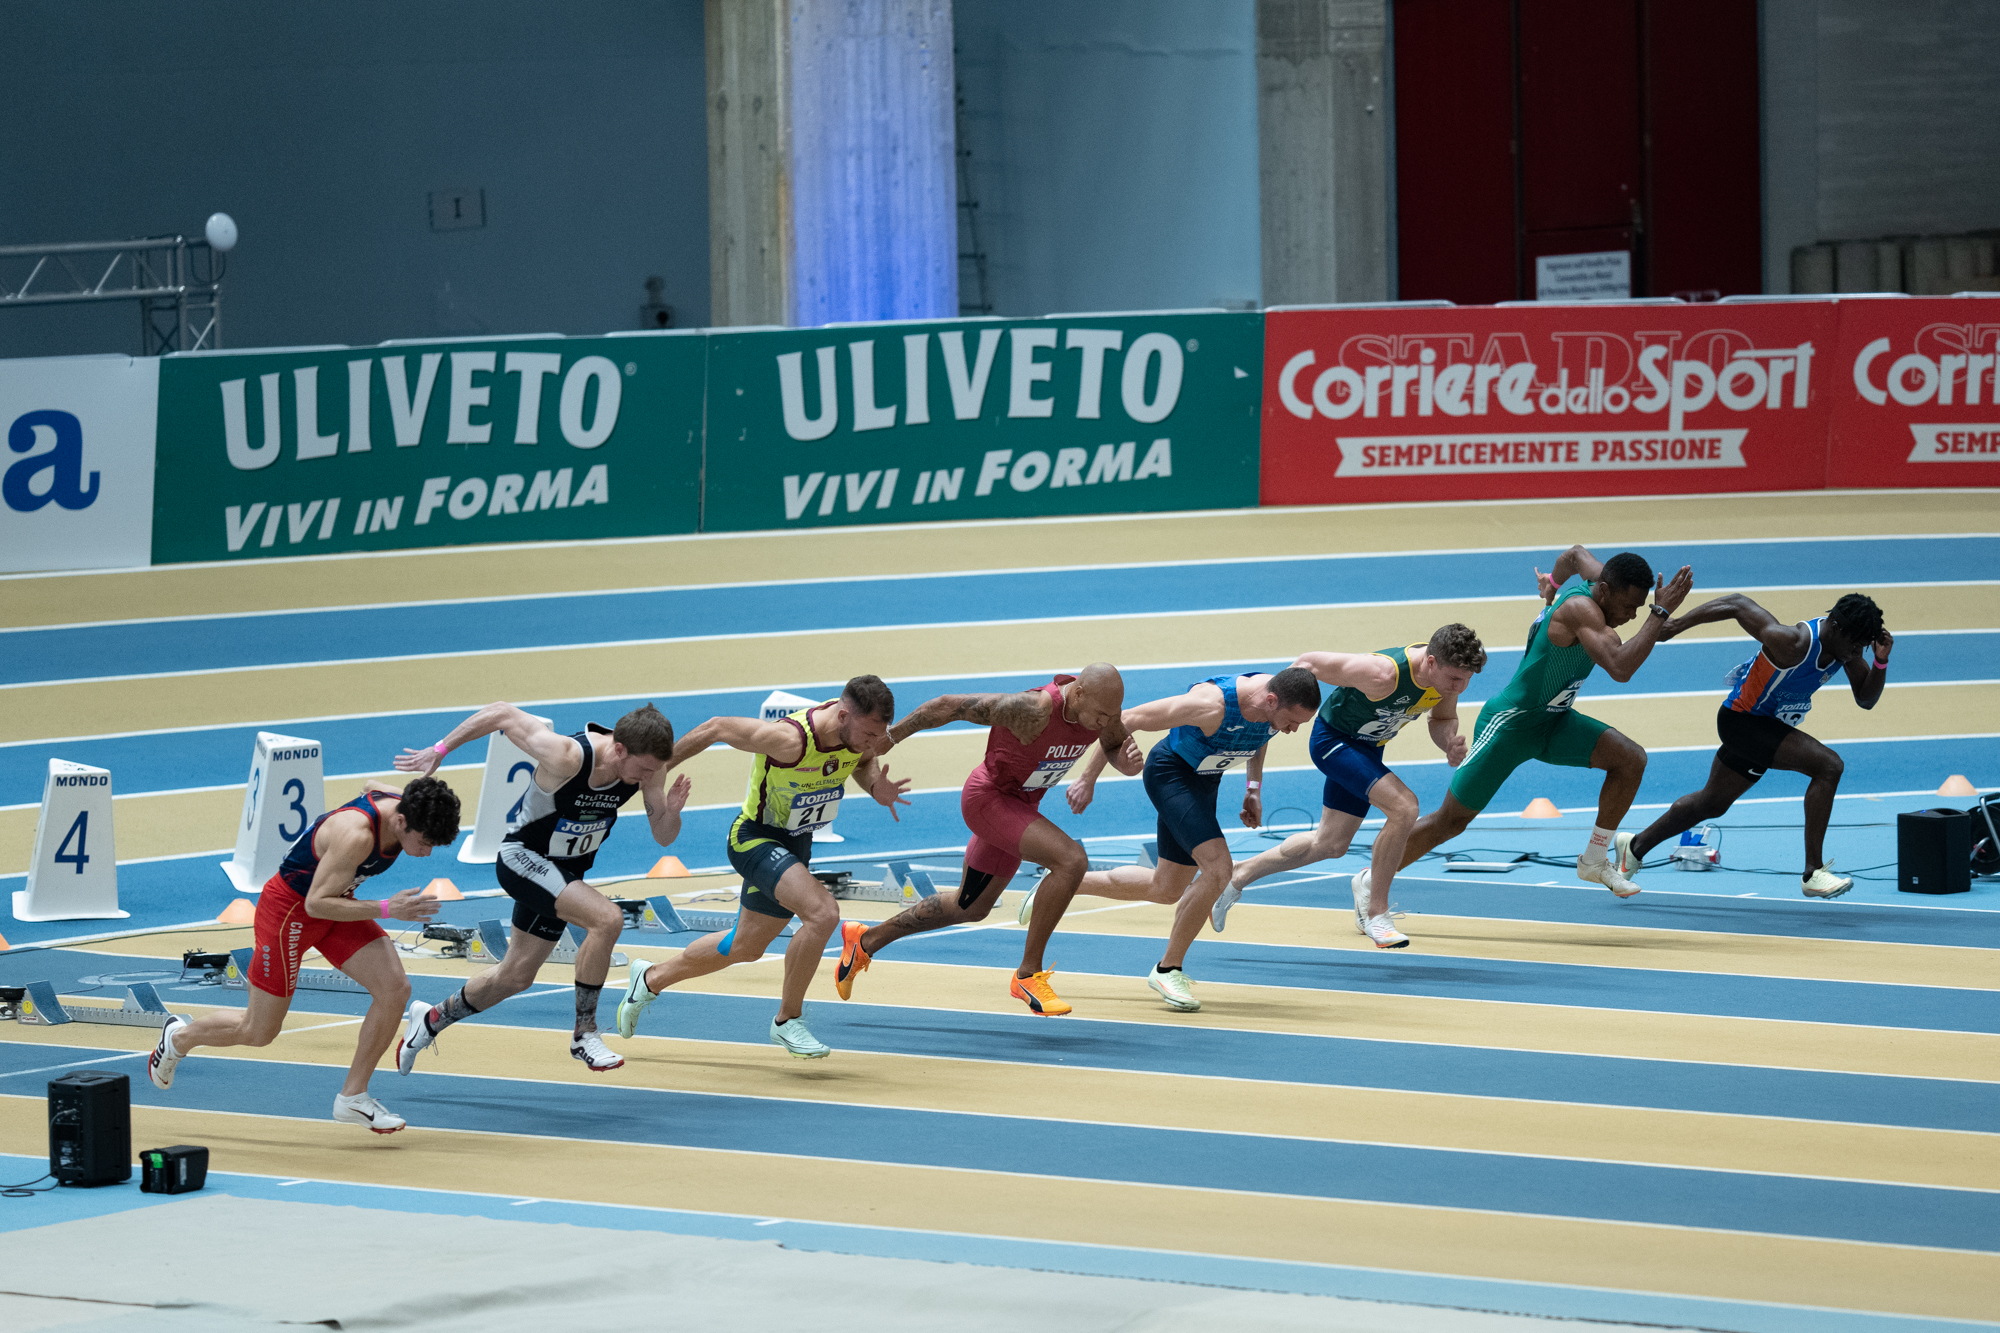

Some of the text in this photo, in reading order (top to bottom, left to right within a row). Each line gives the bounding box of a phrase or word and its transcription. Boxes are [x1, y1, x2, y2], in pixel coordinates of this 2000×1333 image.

[776, 328, 1184, 441] ULIVETO
[1279, 342, 1815, 432] Corriere dello Sport
[220, 352, 622, 470] ULIVETO
[1362, 437, 1721, 468] SEMPLICEMENTE PASSIONE
[783, 438, 1171, 520] VIVI IN FORMA
[225, 464, 609, 552] VIVI IN FORMA
[765, 708, 800, 719] MON
[273, 748, 318, 761] MONDO
[1216, 758, 1235, 769] 6
[56, 776, 108, 787] MONDO
[506, 761, 535, 824] 2
[279, 778, 308, 842] 3
[577, 793, 620, 802] ATLETICA
[797, 789, 840, 806] Joma
[561, 820, 606, 833] Joma
[798, 803, 826, 827] 21
[54, 810, 90, 875] 4
[566, 834, 593, 856] 10
[288, 921, 303, 990] CARABINIERI
